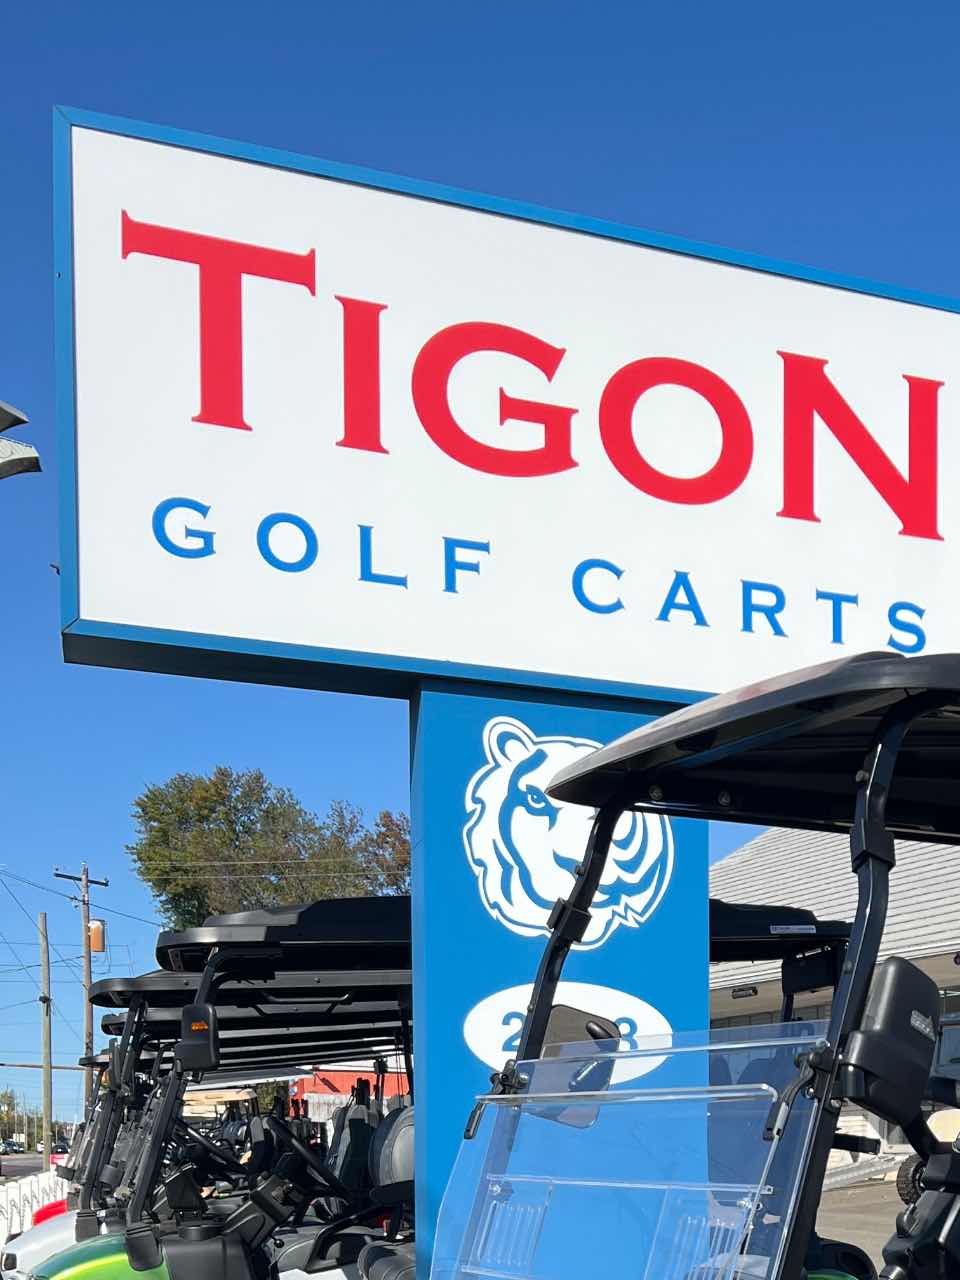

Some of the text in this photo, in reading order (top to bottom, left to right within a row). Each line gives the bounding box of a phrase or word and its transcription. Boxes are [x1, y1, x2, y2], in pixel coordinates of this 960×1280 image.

[121, 209, 945, 541] TIGON
[151, 497, 927, 654] GOLF CARTS
